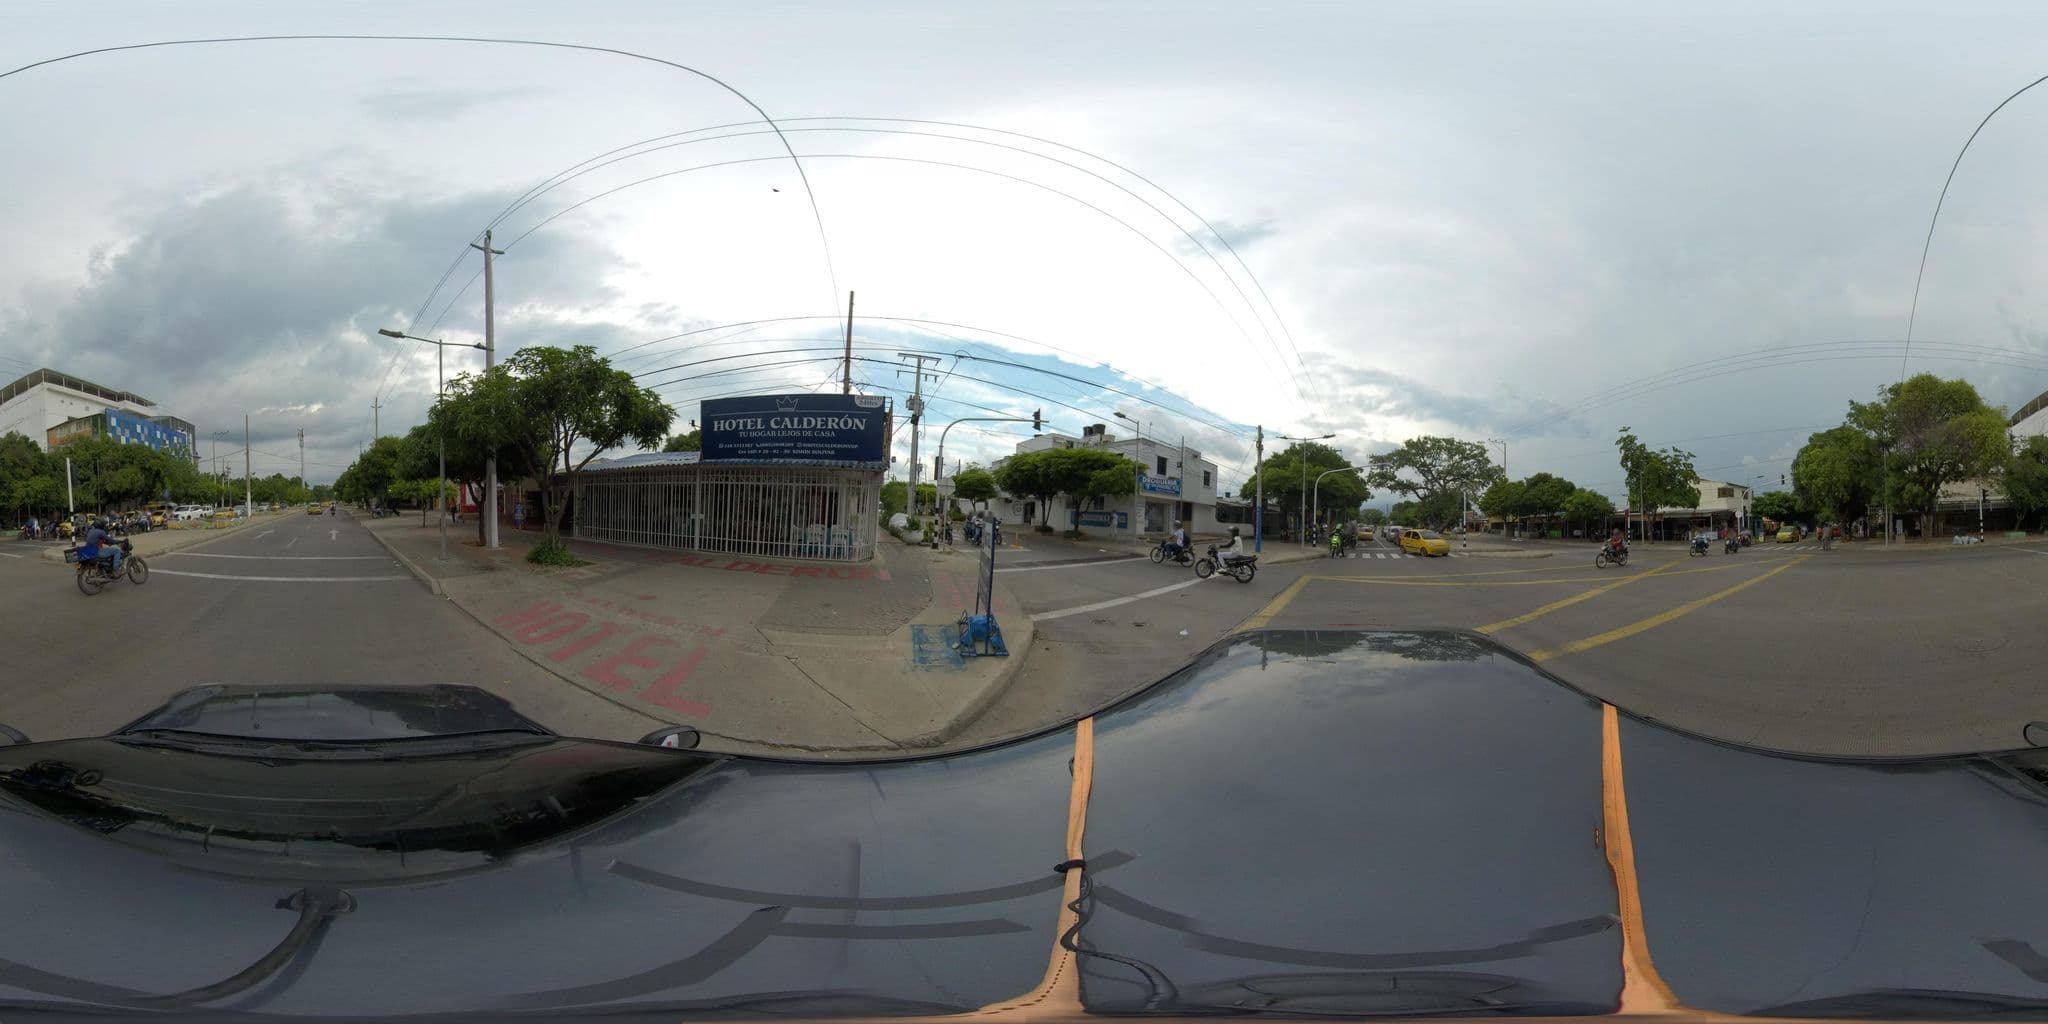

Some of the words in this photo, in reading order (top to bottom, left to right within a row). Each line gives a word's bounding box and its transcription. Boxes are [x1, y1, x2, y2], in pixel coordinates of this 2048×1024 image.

[713, 418, 766, 431] HOTEL
[769, 414, 867, 431] CALDERÓN
[494, 600, 713, 719] HOTEL
